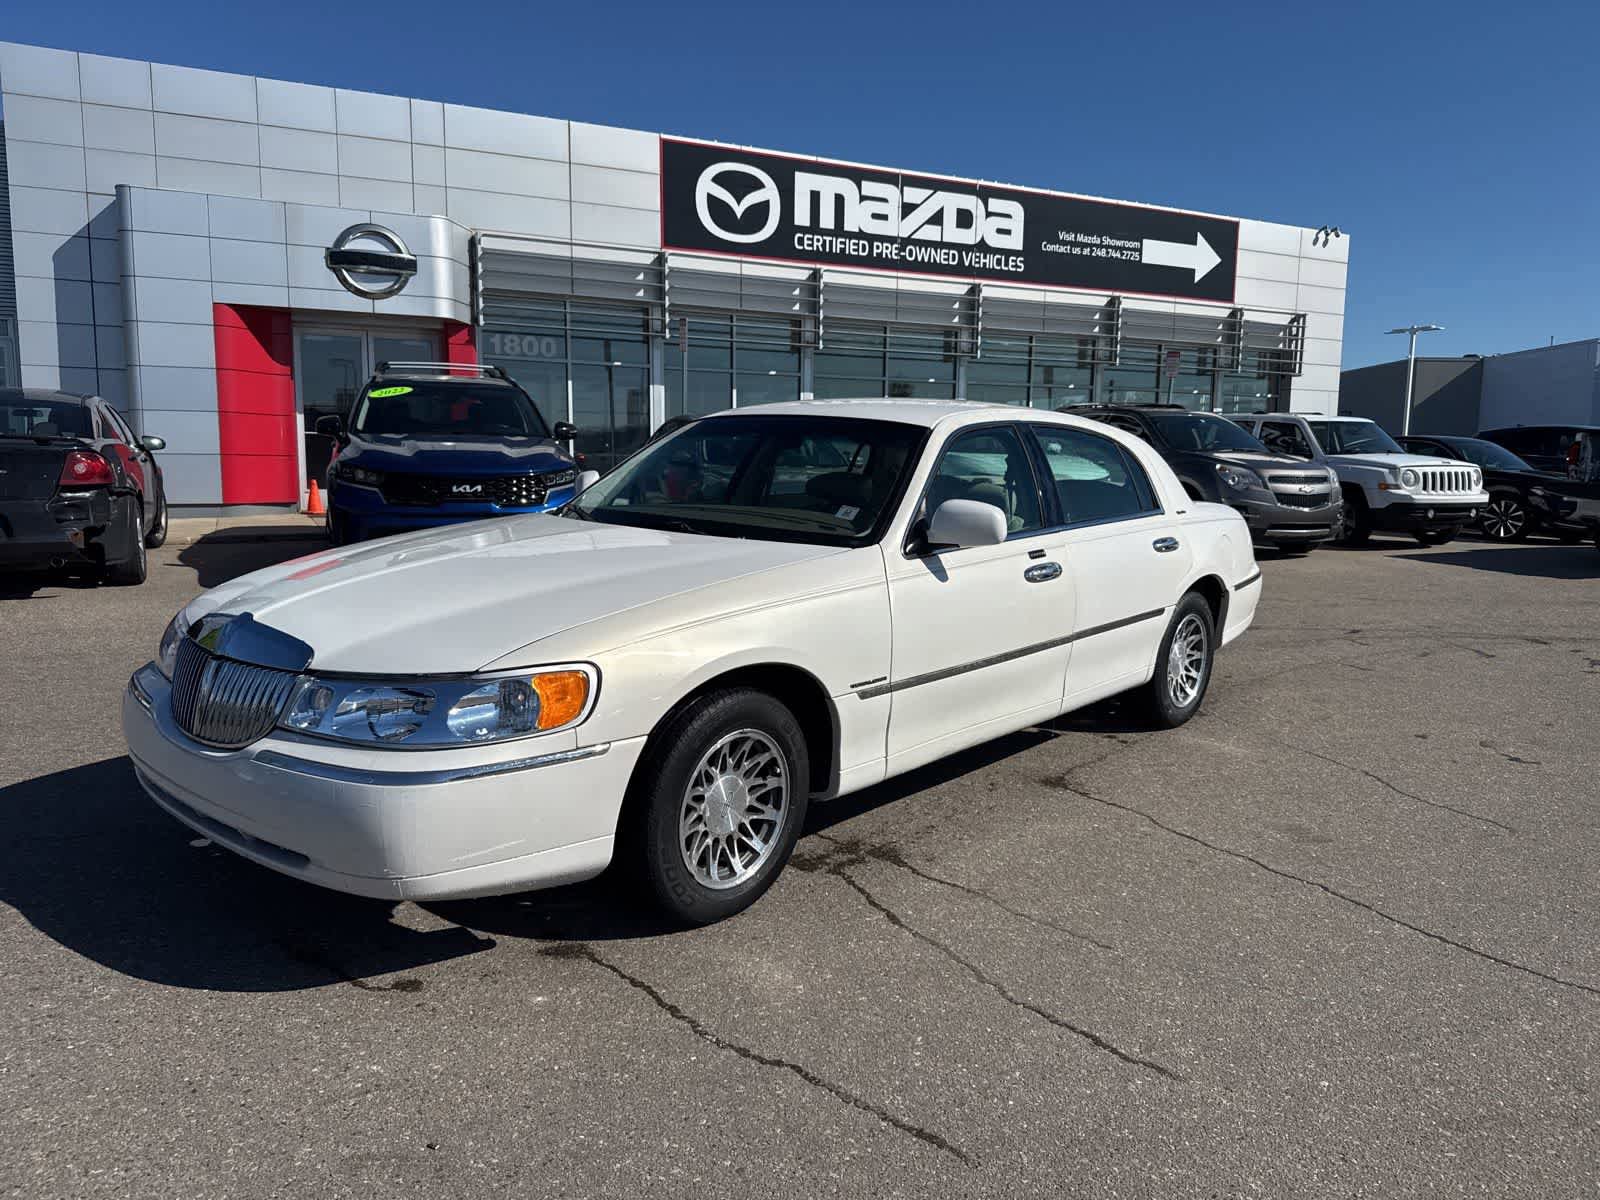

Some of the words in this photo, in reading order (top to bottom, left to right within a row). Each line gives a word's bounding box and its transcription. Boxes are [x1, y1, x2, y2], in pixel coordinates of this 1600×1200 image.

[1058, 231, 1075, 242] Visit
[1076, 233, 1101, 244] Mazda
[1102, 236, 1141, 249] Showroom
[794, 233, 869, 257] CERTIFIED
[873, 242, 959, 265] PRE-OWNED
[962, 250, 1025, 272] VEHICLES
[1041, 241, 1071, 253] Contact
[1072, 246, 1081, 255] us
[1082, 247, 1091, 256] at
[1091, 247, 1140, 261] 248.744.2725
[489, 333, 558, 358] 1800
[452, 484, 482, 493] KIA
